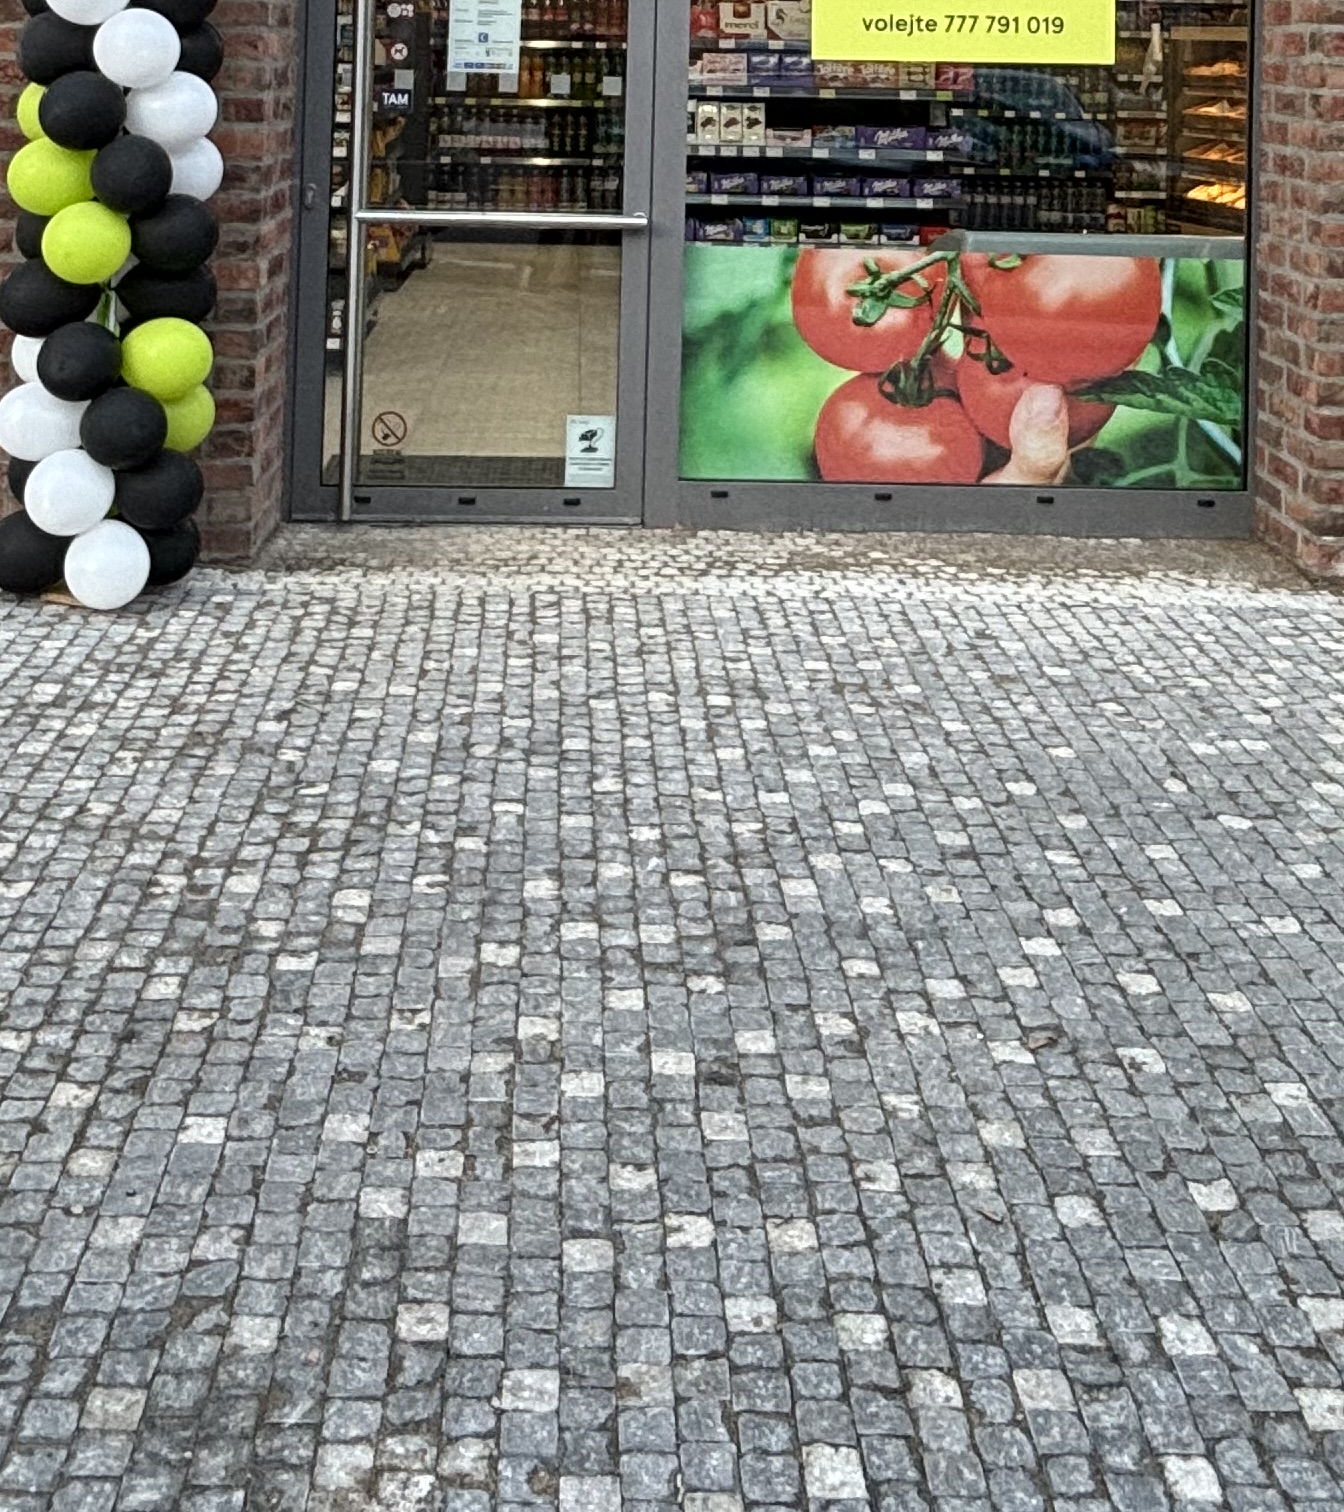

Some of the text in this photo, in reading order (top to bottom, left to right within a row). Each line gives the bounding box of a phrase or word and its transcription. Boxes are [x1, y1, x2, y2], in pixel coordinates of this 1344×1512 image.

[862, 13, 1065, 37] volejte 777 791 019
[382, 92, 409, 106] TAM
